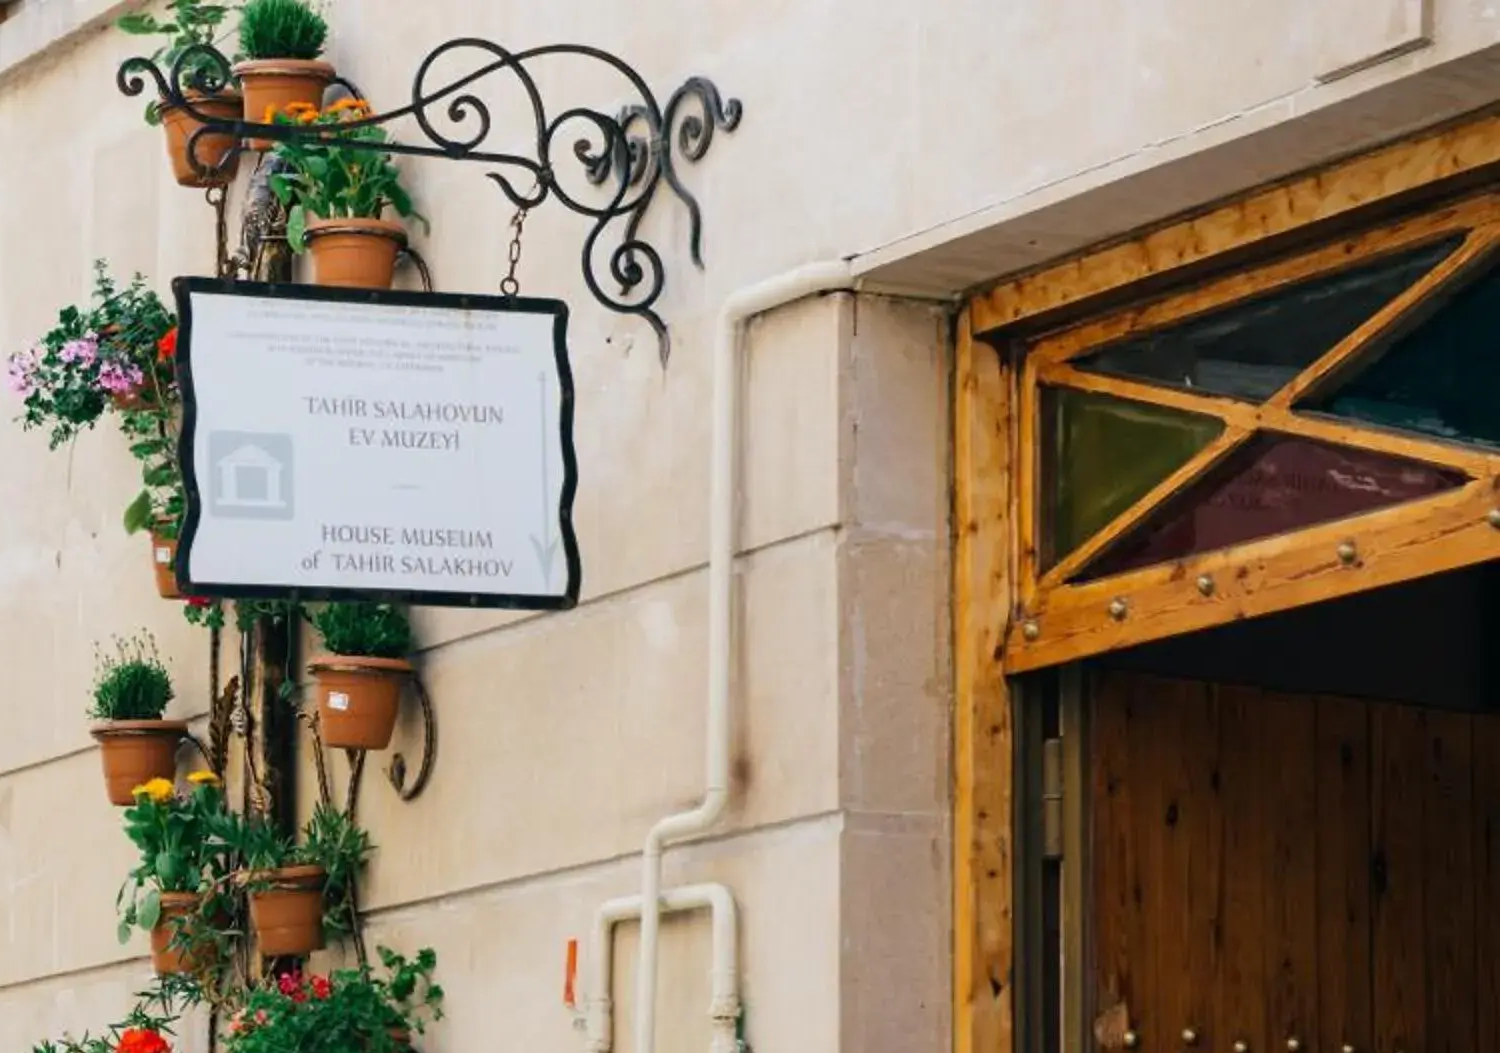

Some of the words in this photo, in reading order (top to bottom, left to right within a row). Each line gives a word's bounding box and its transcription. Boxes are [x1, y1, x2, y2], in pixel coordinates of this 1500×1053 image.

[373, 400, 503, 424] SALAHOVUN
[348, 427, 375, 446] EV
[321, 524, 395, 545] HOUSE
[401, 528, 494, 549] MUSEUM
[301, 551, 321, 570] of
[401, 556, 514, 577] SALAKHOV
